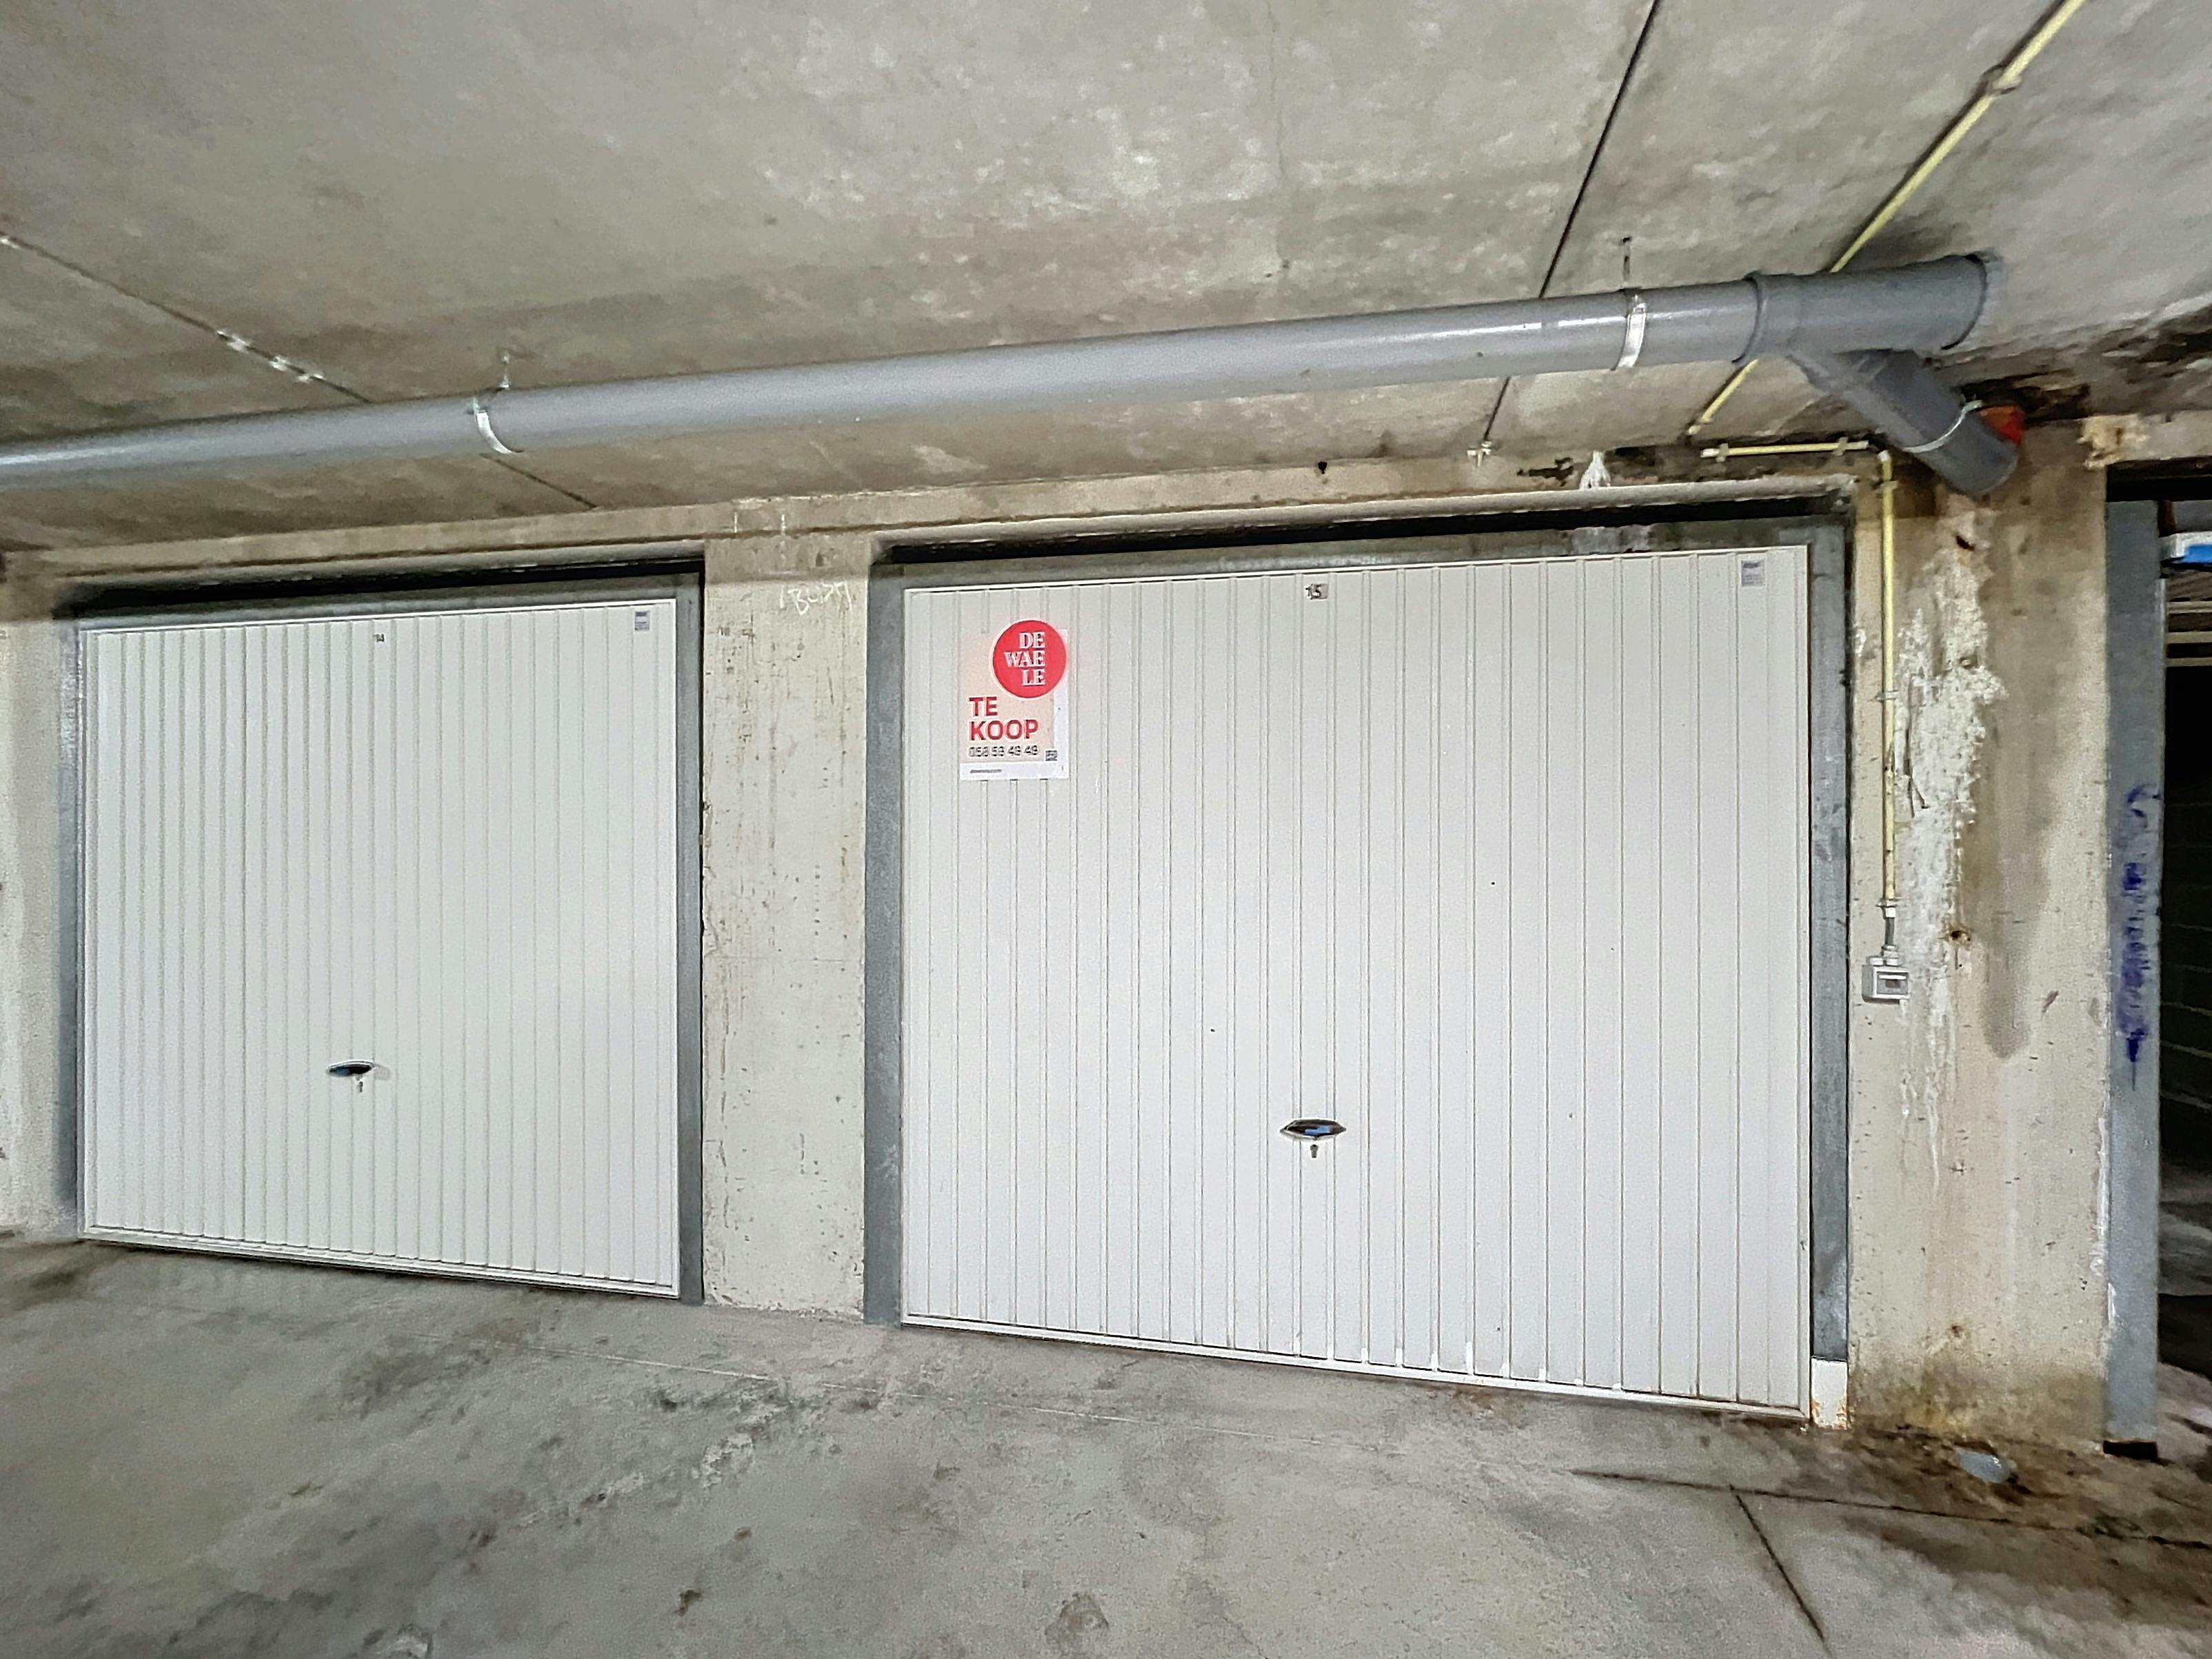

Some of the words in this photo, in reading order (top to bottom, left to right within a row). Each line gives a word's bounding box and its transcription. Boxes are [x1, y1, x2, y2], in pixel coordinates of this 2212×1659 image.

[1019, 632, 1045, 649] DE
[1004, 650, 1045, 667] WAE
[1022, 669, 1045, 685] LE
[969, 696, 998, 716] TE
[969, 719, 1038, 741] KOOP
